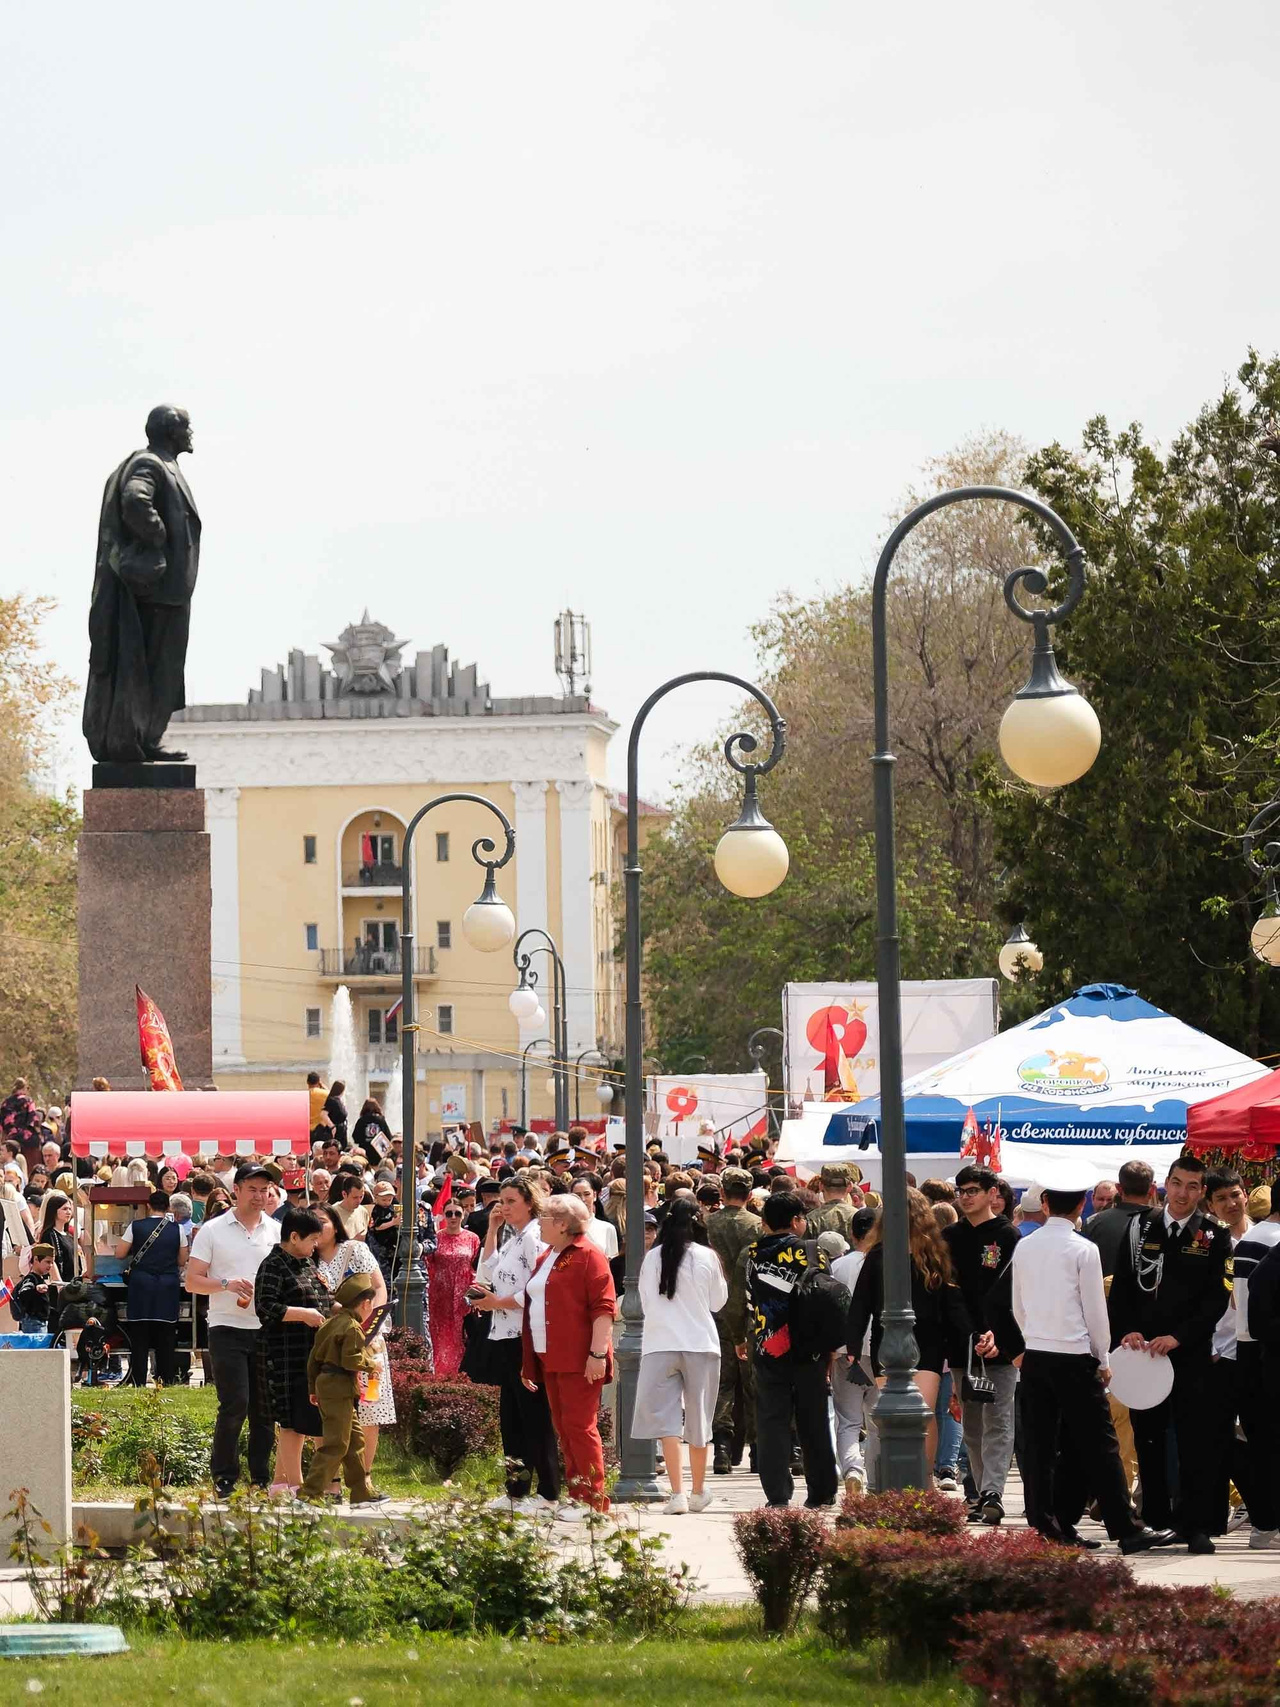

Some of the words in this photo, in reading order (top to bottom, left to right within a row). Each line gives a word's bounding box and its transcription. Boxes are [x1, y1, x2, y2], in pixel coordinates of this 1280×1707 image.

[1126, 1066, 1206, 1076] Любимое
[1127, 1080, 1230, 1089] мороженое!
[666, 1087, 698, 1121] 9
[1012, 1122, 1111, 1140] свежайших
